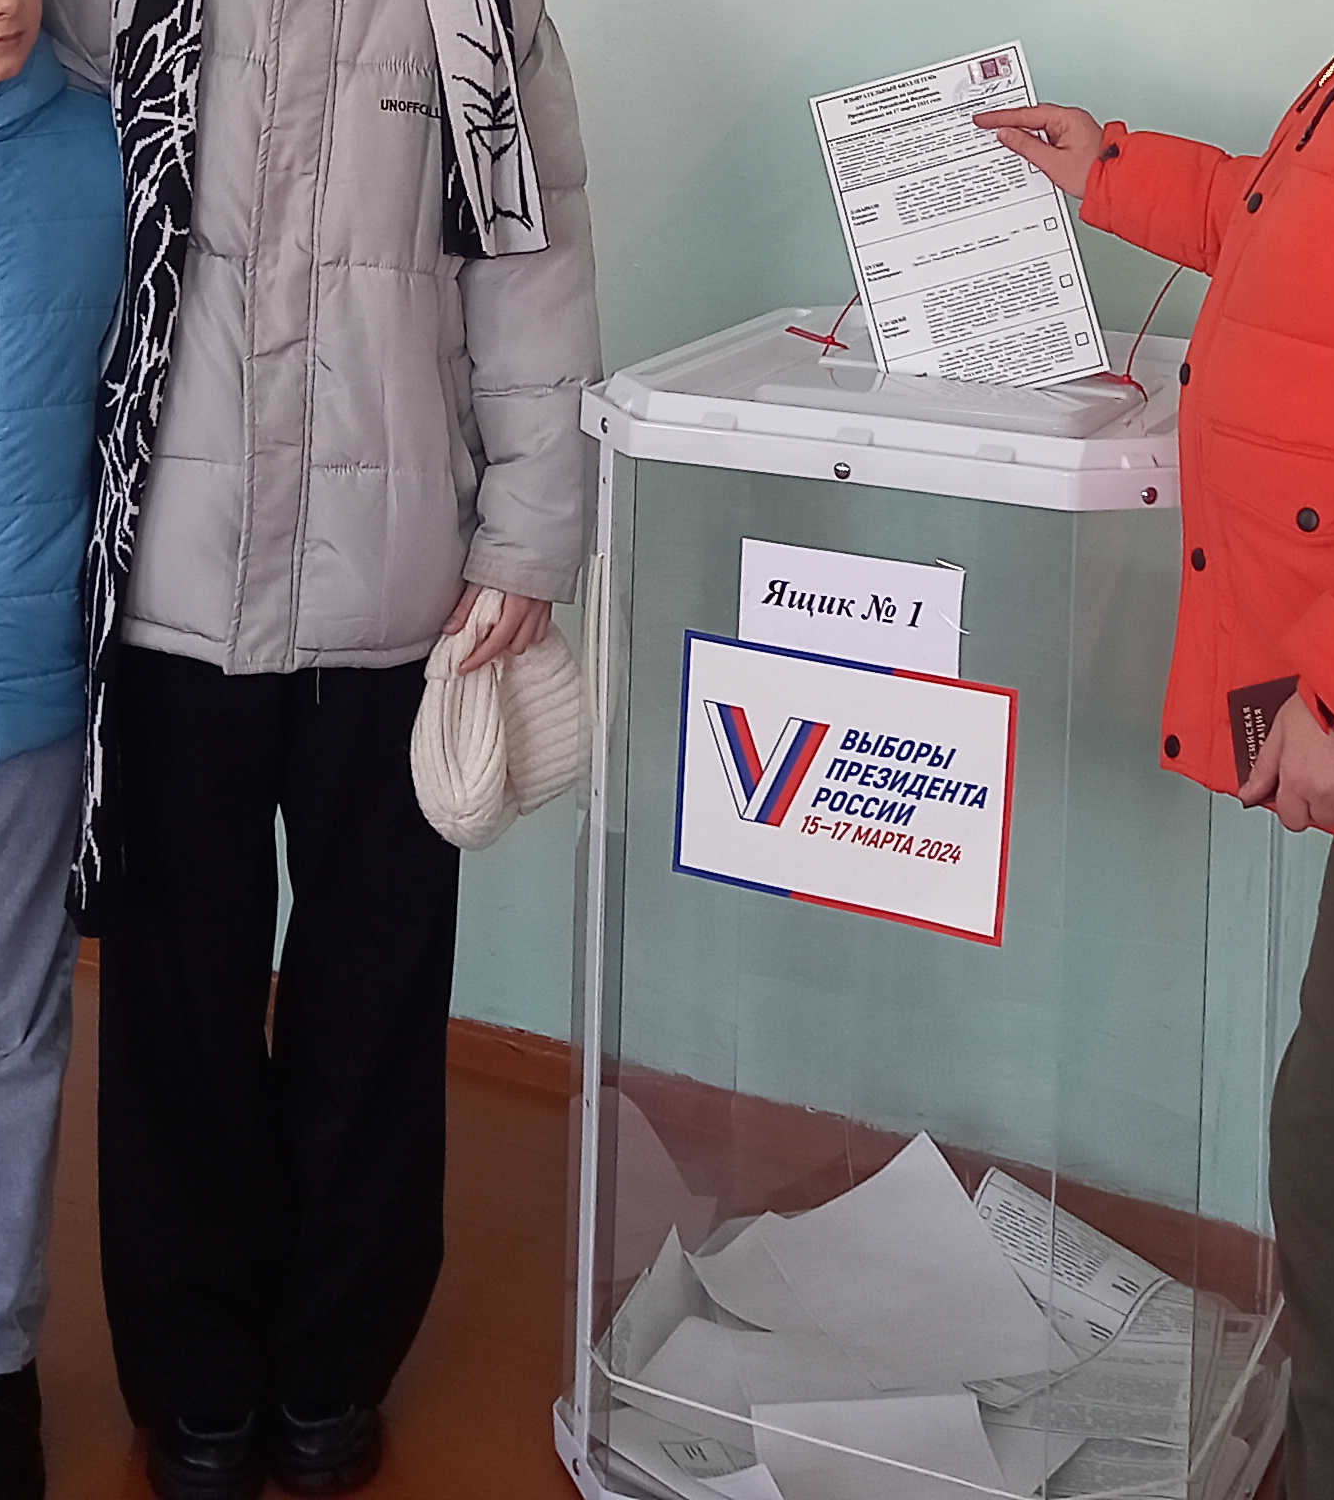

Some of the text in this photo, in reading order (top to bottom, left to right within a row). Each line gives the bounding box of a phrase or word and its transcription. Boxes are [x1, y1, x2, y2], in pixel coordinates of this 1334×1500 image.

[761, 579, 923, 628] Ящик № 1
[840, 729, 957, 769] ВЫБОРЫ
[825, 758, 989, 809] ПРЕЗИДЕНТА
[811, 787, 916, 826] РОССИИ
[851, 825, 915, 855] МАРТА
[916, 838, 962, 864] 2024
